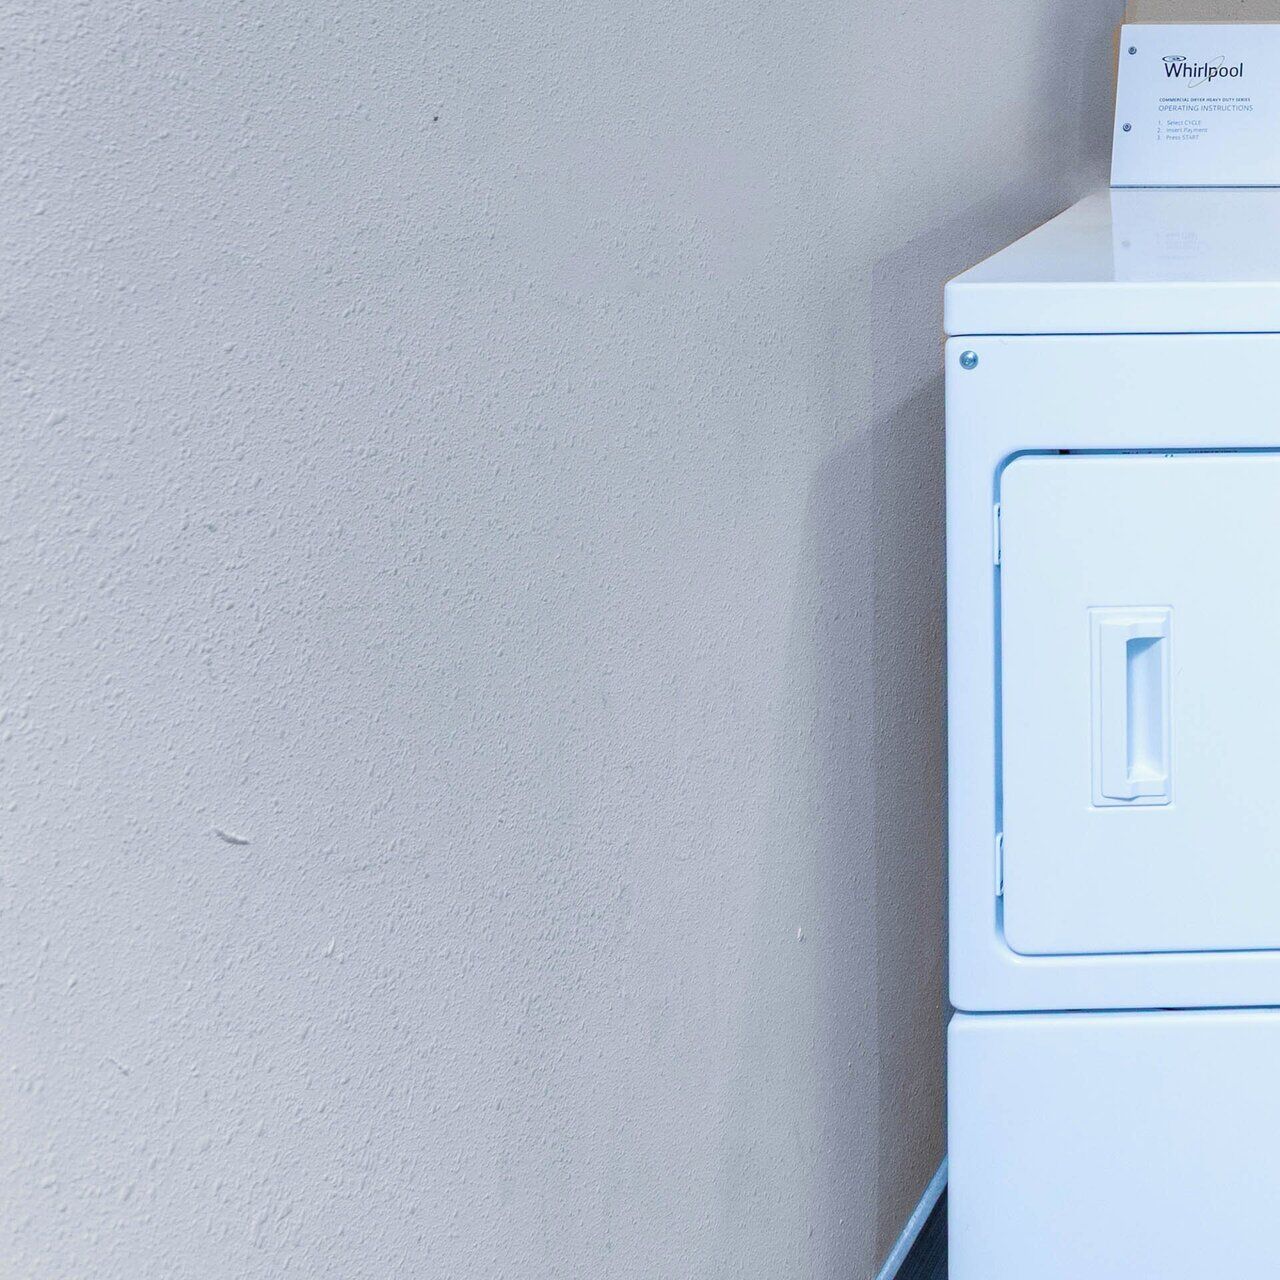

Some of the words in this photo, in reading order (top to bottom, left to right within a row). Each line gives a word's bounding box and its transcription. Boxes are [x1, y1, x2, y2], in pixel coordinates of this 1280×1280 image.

[1164, 62, 1243, 82] Whirlpool
[1158, 104, 1199, 112] OPERATING
[1200, 104, 1254, 112] INSTRUCTIONS
